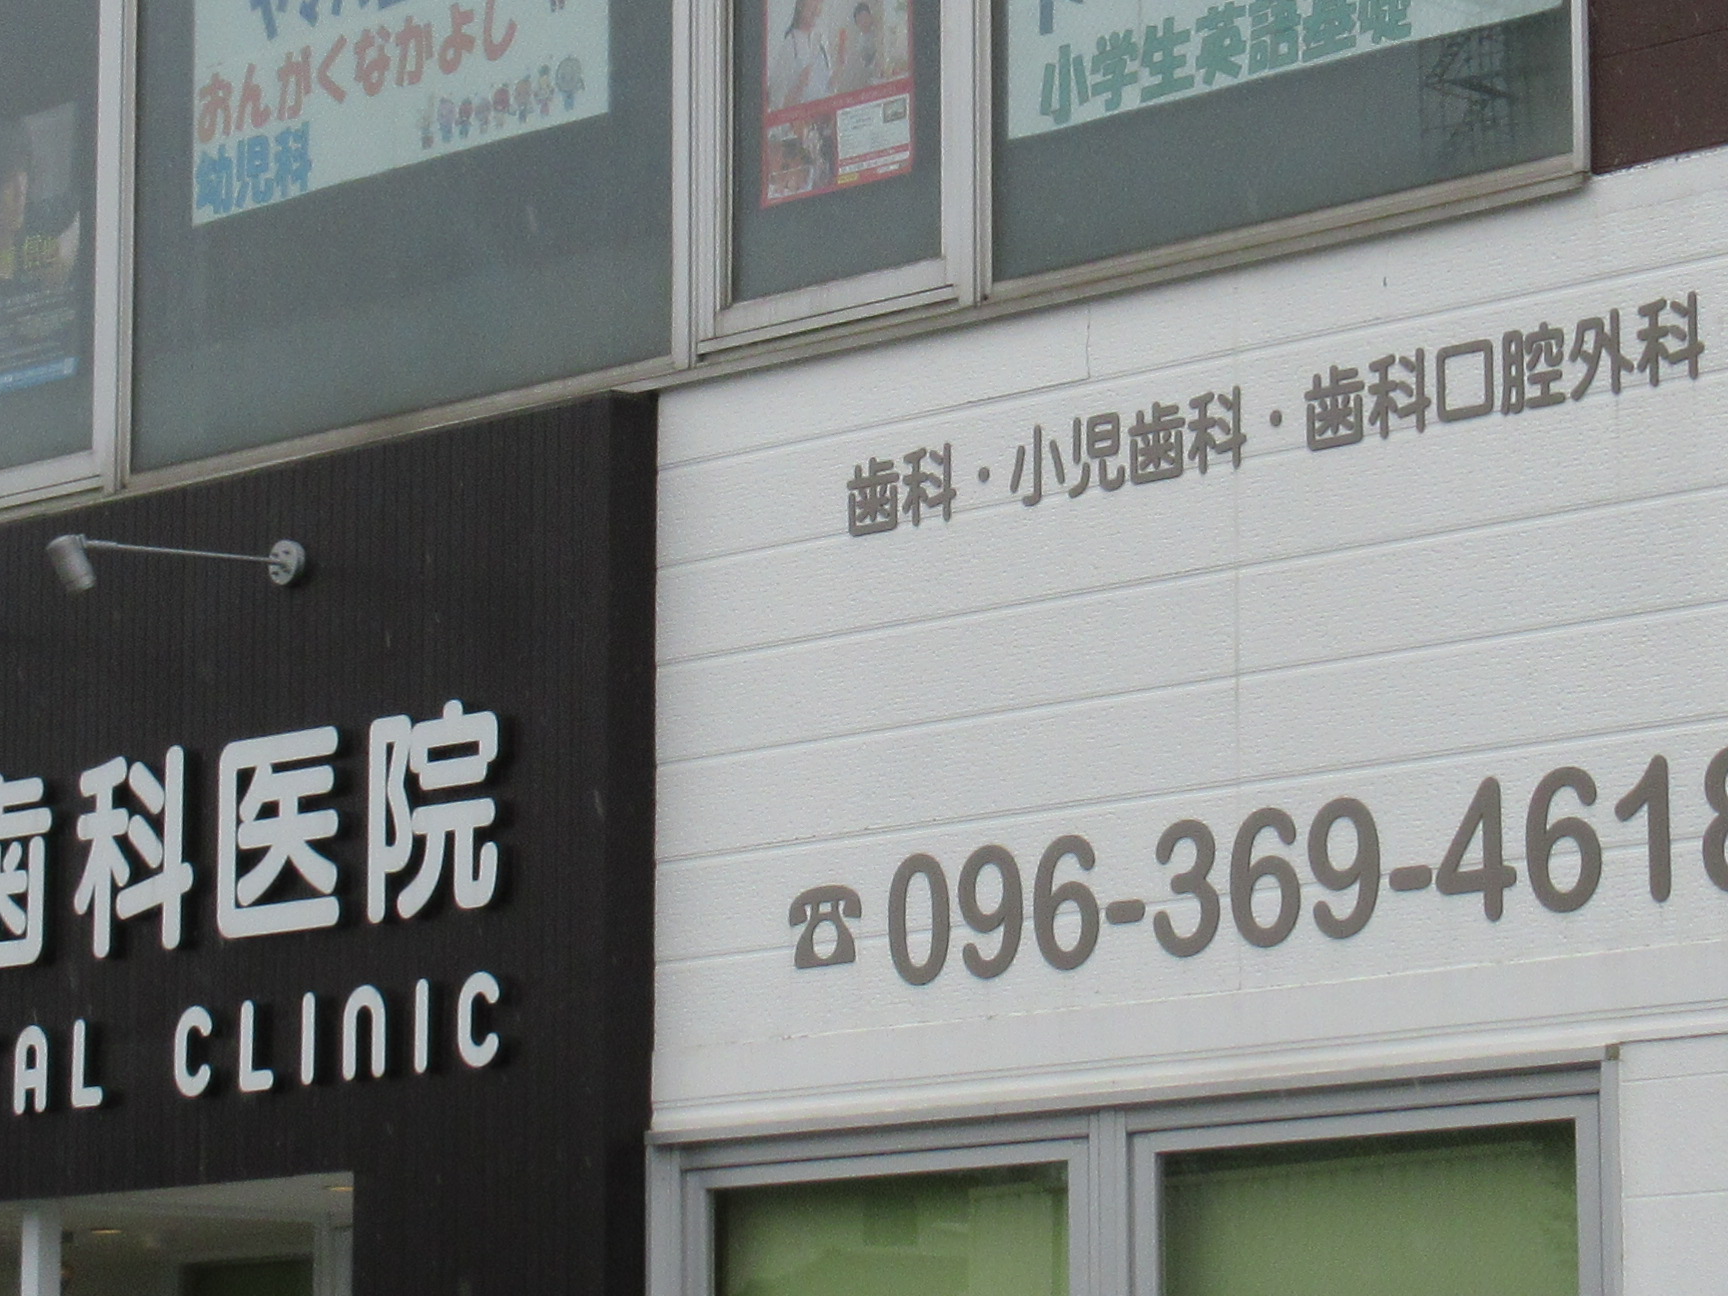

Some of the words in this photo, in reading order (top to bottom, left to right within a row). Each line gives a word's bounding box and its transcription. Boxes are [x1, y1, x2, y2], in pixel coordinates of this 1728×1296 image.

[195, 121, 313, 214] 幼児科
[174, 970, 501, 1097] CLINIC
